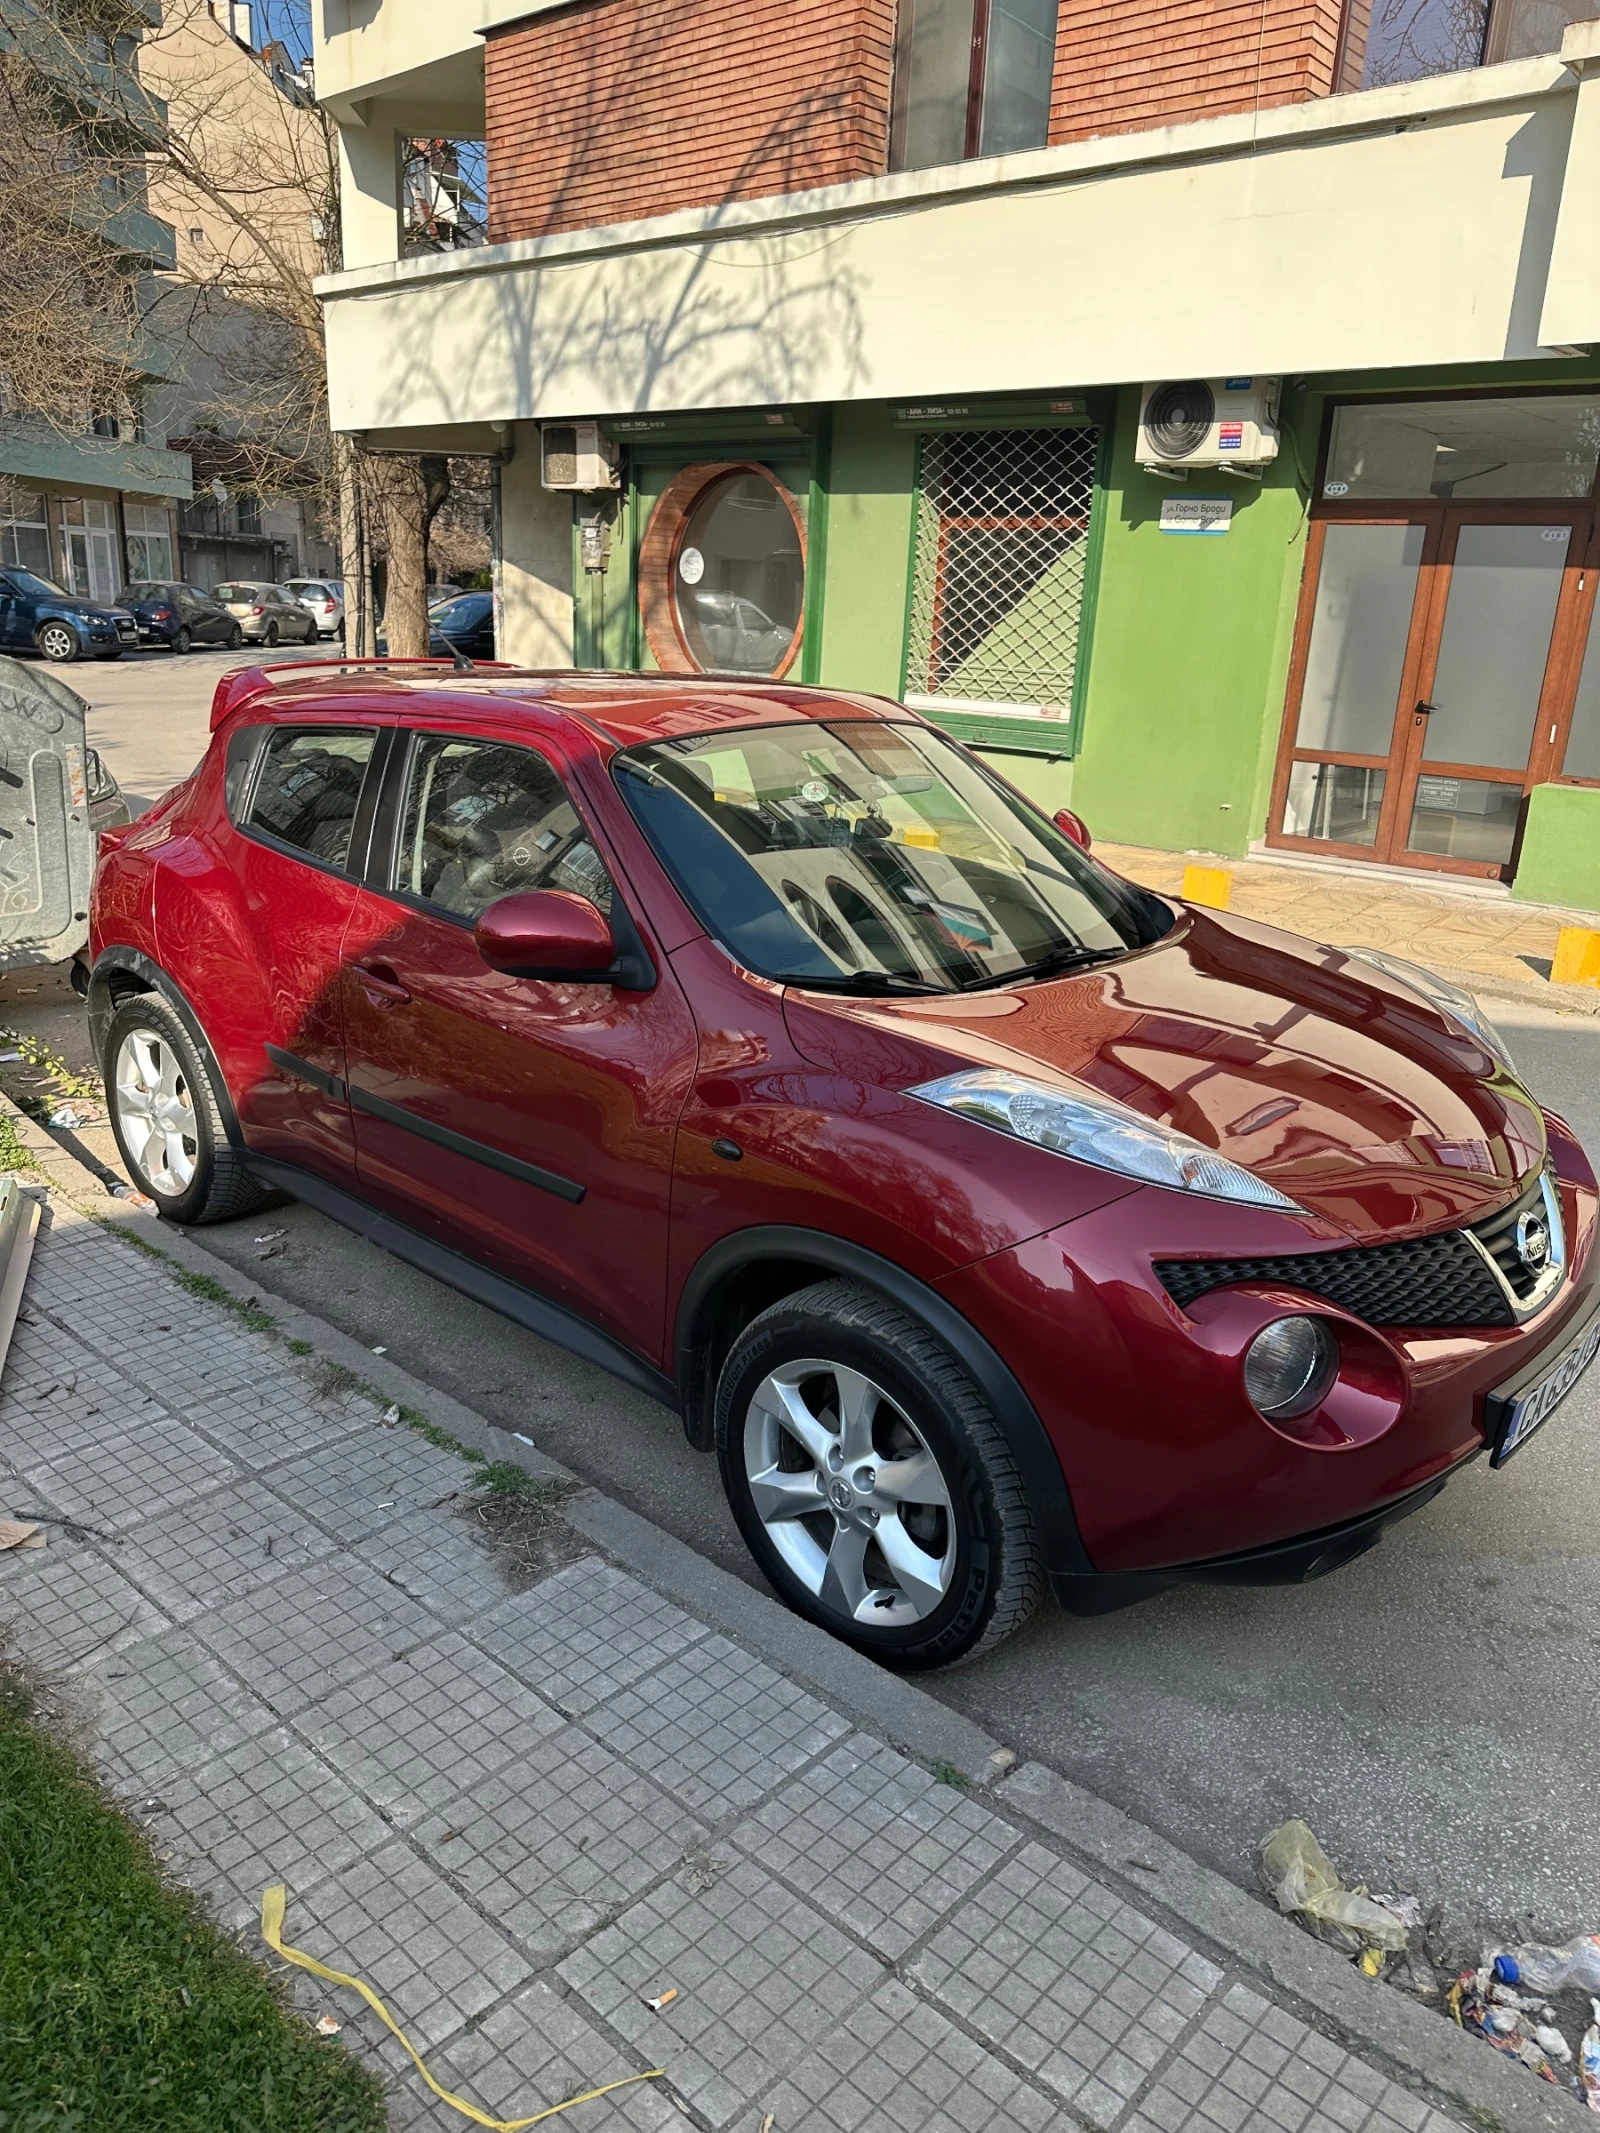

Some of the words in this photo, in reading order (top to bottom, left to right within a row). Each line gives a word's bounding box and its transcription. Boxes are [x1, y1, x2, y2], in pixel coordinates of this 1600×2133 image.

[1175, 504, 1198, 514] Горно
[1200, 504, 1226, 514] Броди
[1200, 515, 1221, 524] Brodi
[923, 1566, 987, 1652] Petlas
